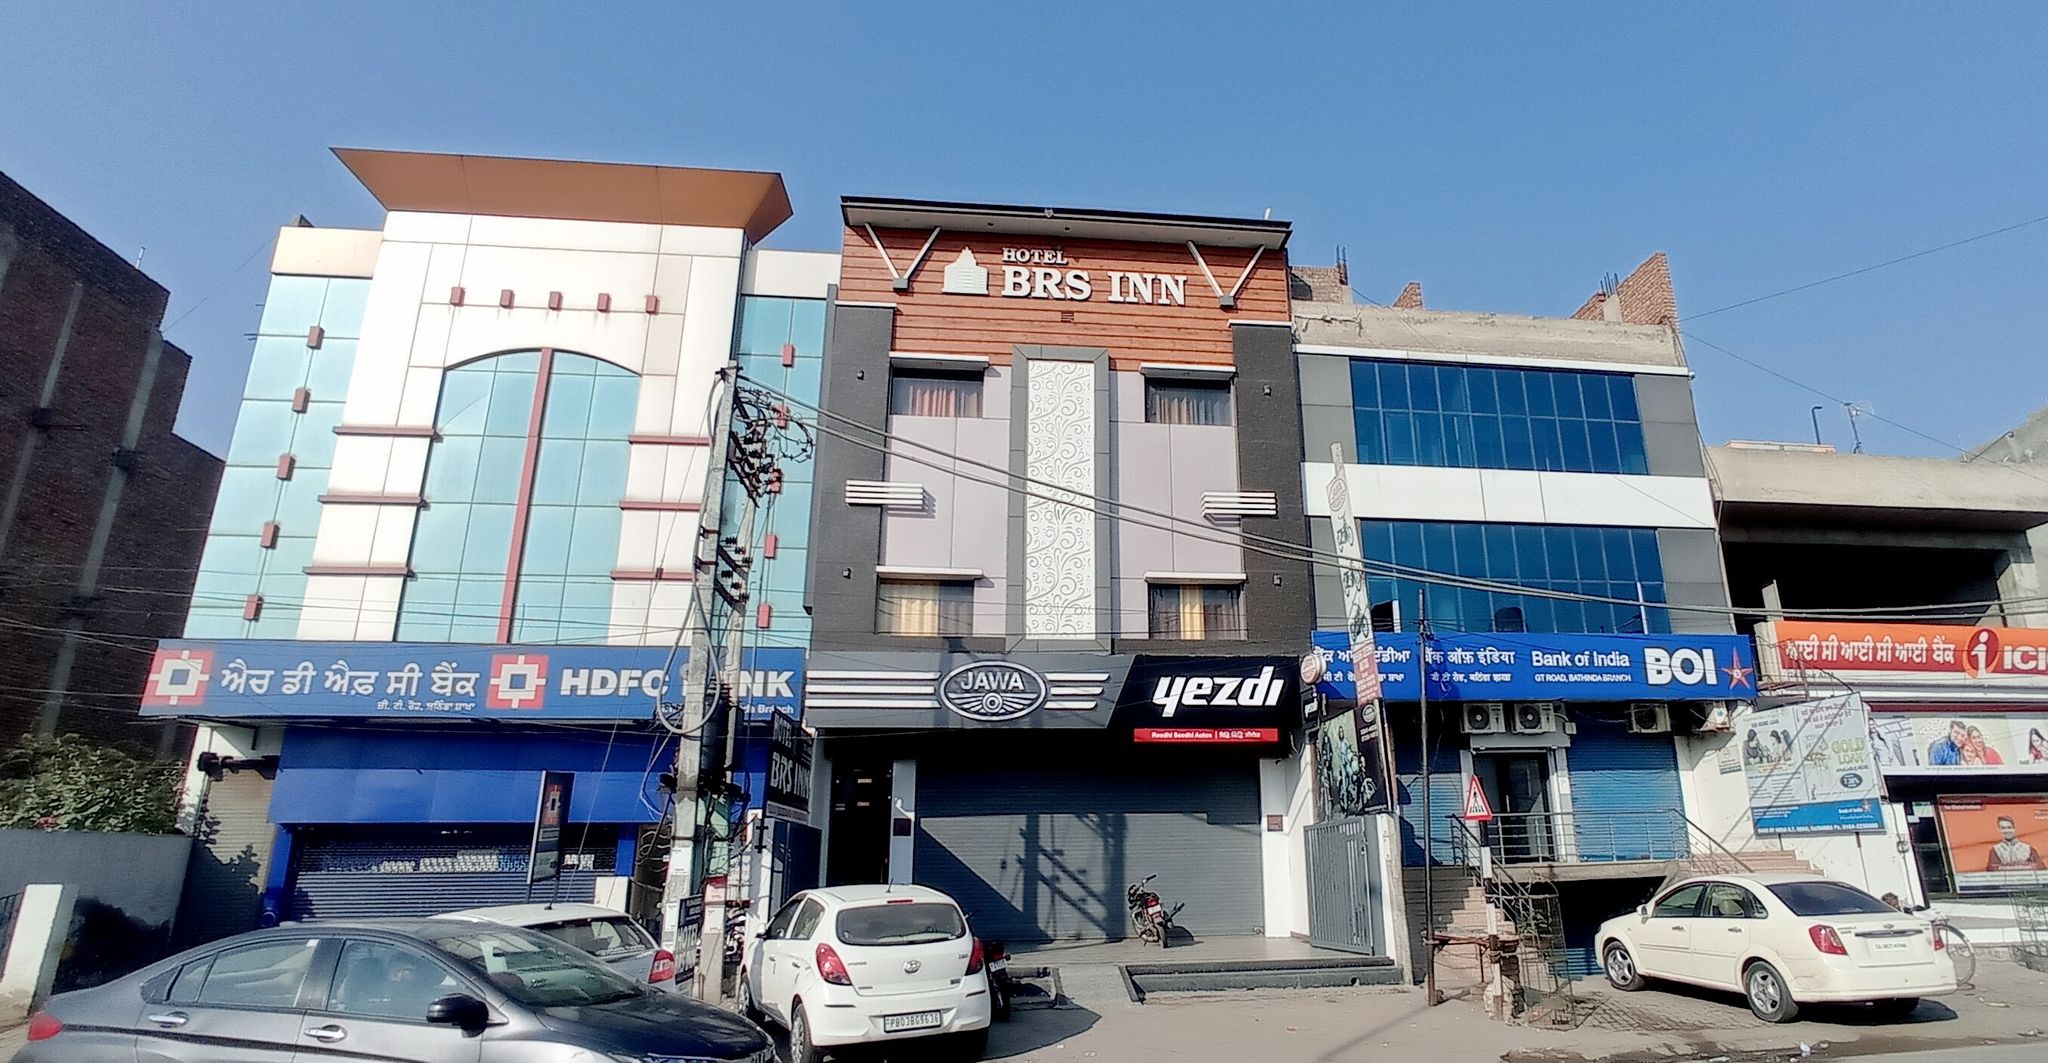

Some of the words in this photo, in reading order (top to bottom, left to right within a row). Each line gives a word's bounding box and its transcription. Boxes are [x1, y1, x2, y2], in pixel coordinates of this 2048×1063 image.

[1002, 247, 1068, 265] HOTEL
[1001, 265, 1092, 300] BRS
[1107, 271, 1187, 306] INN
[1476, 646, 1516, 666] इंडिया
[1531, 650, 1572, 667] Bank
[1574, 650, 1591, 667] of
[1592, 650, 1630, 667] India
[1820, 633, 1838, 662] ਸੀ
[1840, 634, 1873, 663] ਆਈ
[1875, 635, 1892, 664] ਸੀ
[1894, 635, 1928, 664] ਆਈ
[1931, 634, 1956, 665] ਬੈਂਕ
[220, 658, 275, 695] ਐਚ
[281, 660, 317, 695] ਡੀ
[386, 661, 423, 697] ਸੀ
[430, 661, 480, 697] ਬੈਂਕ
[960, 671, 1025, 691] JAWA
[1534, 673, 1545, 682] GT
[1568, 674, 1602, 682] BATHINDA
[1602, 674, 1632, 682] BRANCH
[1644, 647, 1718, 686] BOI
[560, 668, 670, 698] HDFC
[682, 670, 796, 699] NK
[1152, 665, 1285, 718] yezdi
[770, 752, 793, 794] BRS
